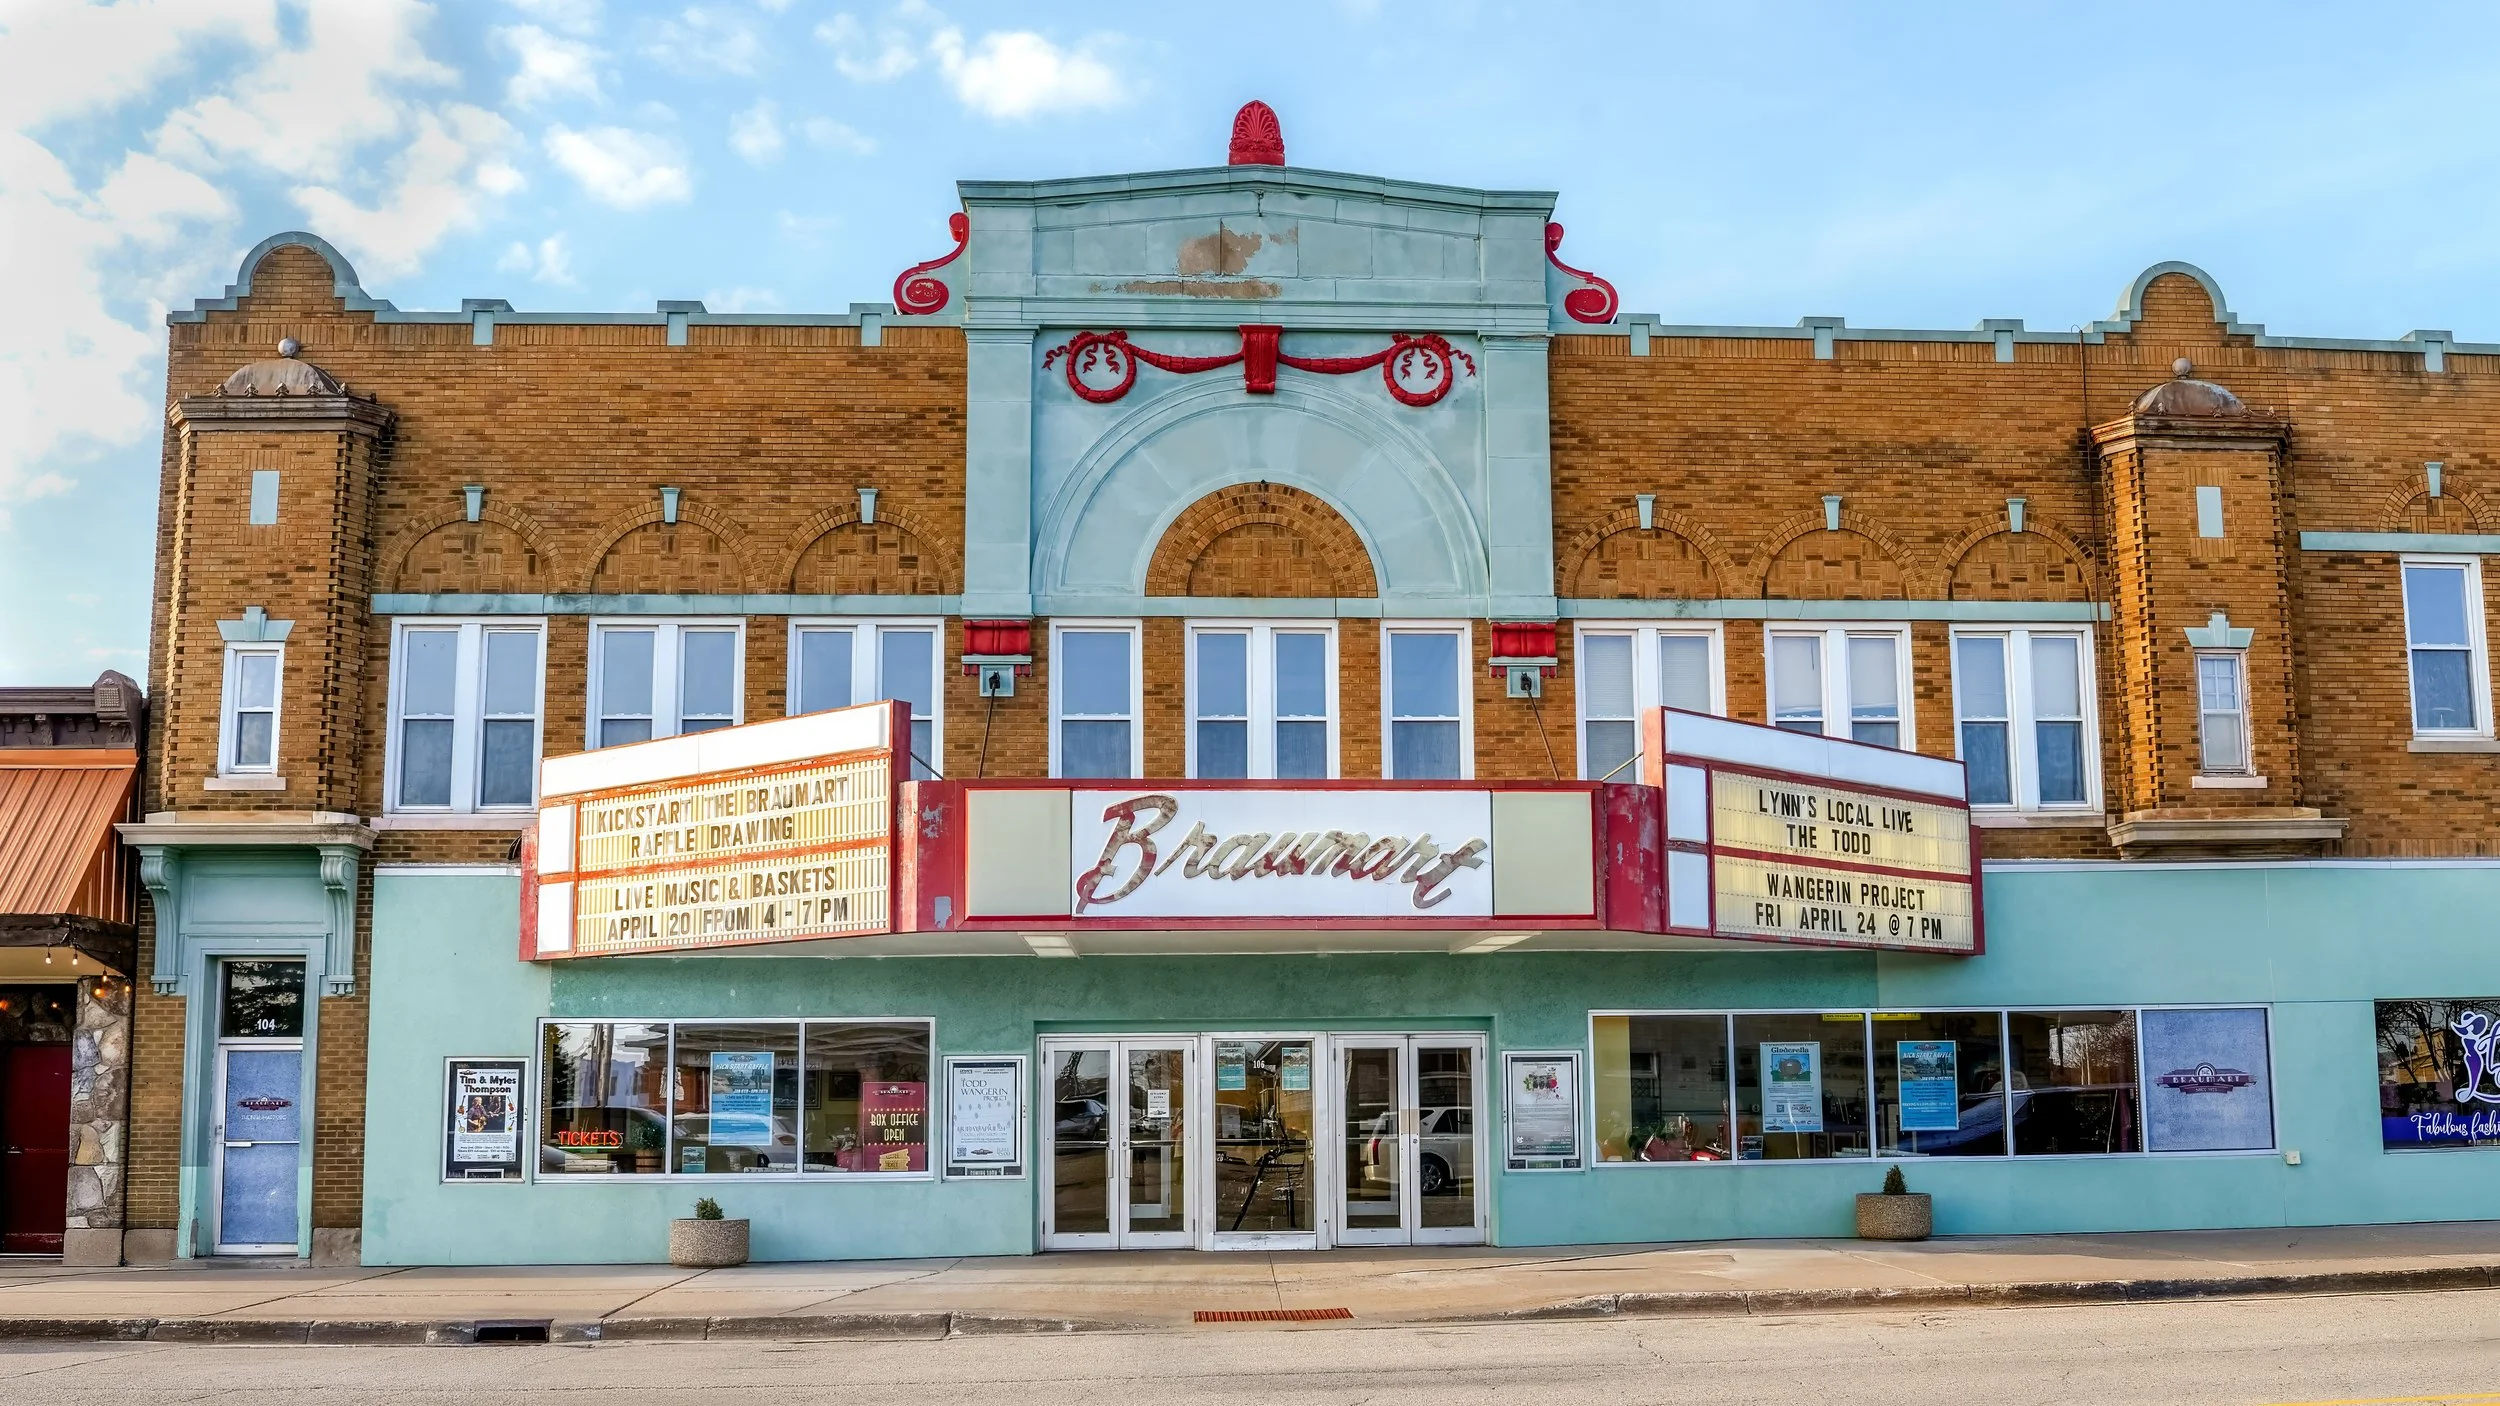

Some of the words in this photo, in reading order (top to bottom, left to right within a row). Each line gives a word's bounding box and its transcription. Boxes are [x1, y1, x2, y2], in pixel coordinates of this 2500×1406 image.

[598, 799, 691, 833] KICKSTART
[704, 793, 735, 818] THE
[746, 777, 848, 814] BRAUMART
[1759, 789, 1817, 818] LYNN'S
[1828, 799, 1874, 827] LOCAL
[1882, 806, 1913, 834] LIVE
[631, 828, 695, 858] RAFFLE
[711, 816, 793, 849] DRAWING
[1076, 793, 1488, 914] Braumart
[1787, 823, 1817, 849] THE
[1832, 829, 1871, 855] TODD
[615, 885, 654, 911] LIVE
[665, 874, 719, 906] MUSIC
[729, 876, 741, 899] &
[752, 866, 835, 897] BASKETS
[1767, 873, 1851, 903] WANGERIN
[1861, 883, 1925, 910] PROJECT
[608, 915, 657, 941] APRIL
[669, 911, 690, 936] 20
[764, 904, 775, 928] 4
[803, 900, 812, 924] 7
[821, 897, 848, 923] PM
[1756, 903, 1782, 927] FRI
[1800, 907, 1847, 933] APRIL
[1857, 912, 1876, 935] 24
[1889, 914, 1900, 936] @
[1907, 917, 1914, 937] 7
[1922, 918, 1942, 940] PM
[257, 1019, 275, 1030] 104
[460, 1076, 476, 1084] Tim
[480, 1076, 486, 1084] &
[490, 1076, 516, 1085] Myles
[464, 1085, 511, 1094] Thompson
[870, 1114, 886, 1126] BOX
[891, 1114, 918, 1125] OFFICE
[884, 1129, 905, 1141] OPEN
[2411, 1112, 2468, 1141] Fabulous
[558, 1131, 620, 1146] TICKETS
